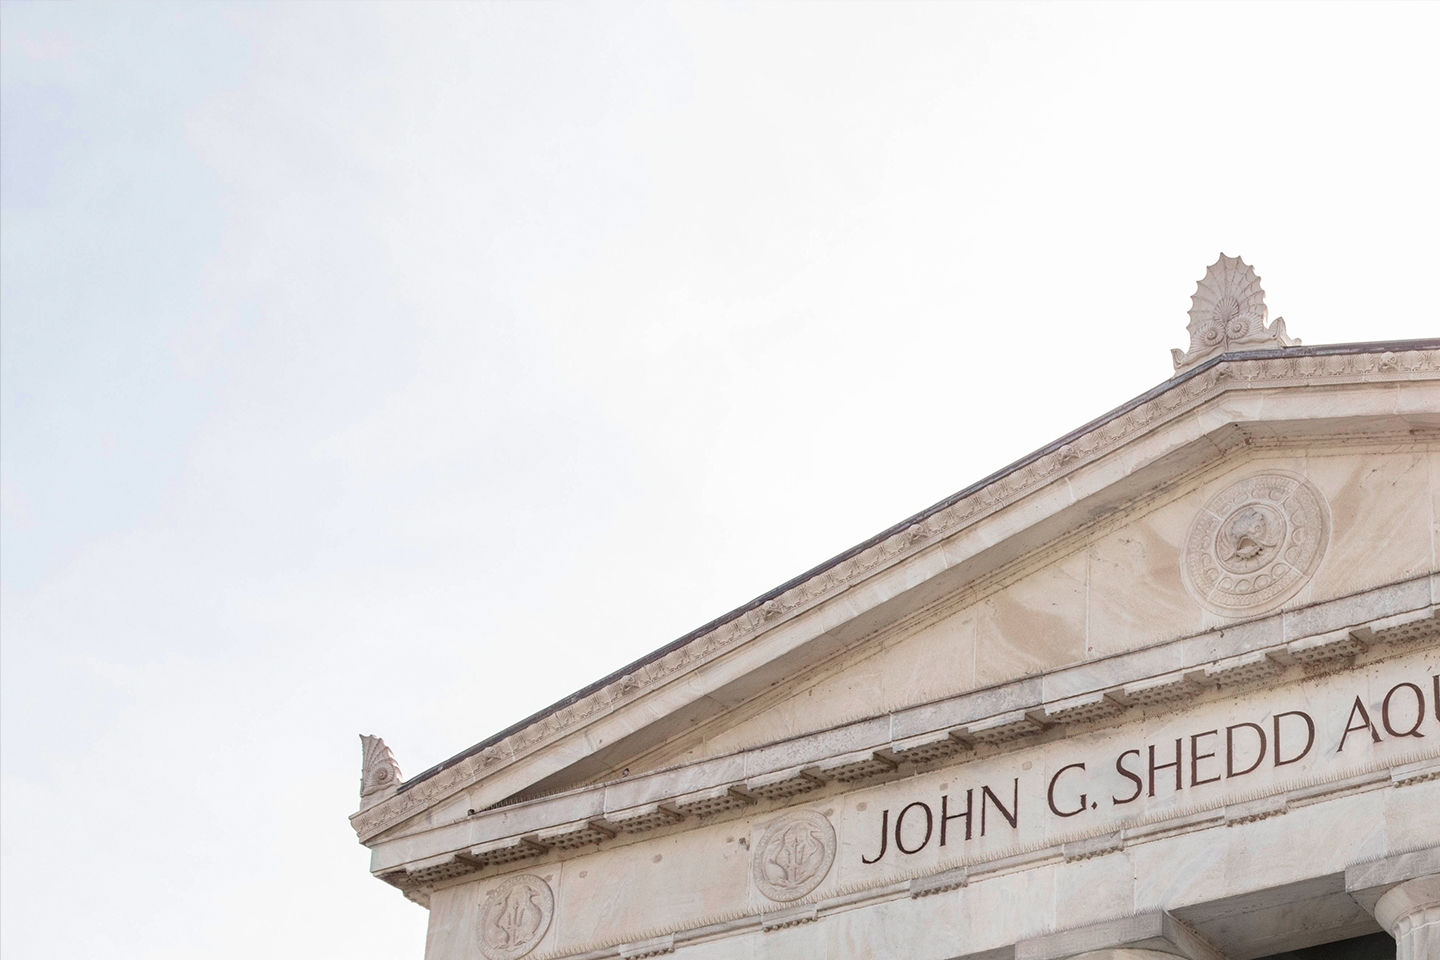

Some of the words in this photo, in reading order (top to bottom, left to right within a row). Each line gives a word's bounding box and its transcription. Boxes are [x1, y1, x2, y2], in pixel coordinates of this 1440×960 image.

[861, 778, 1019, 864] JOHN
[1047, 762, 1097, 818] G.
[1112, 711, 1315, 806] SHEDD
